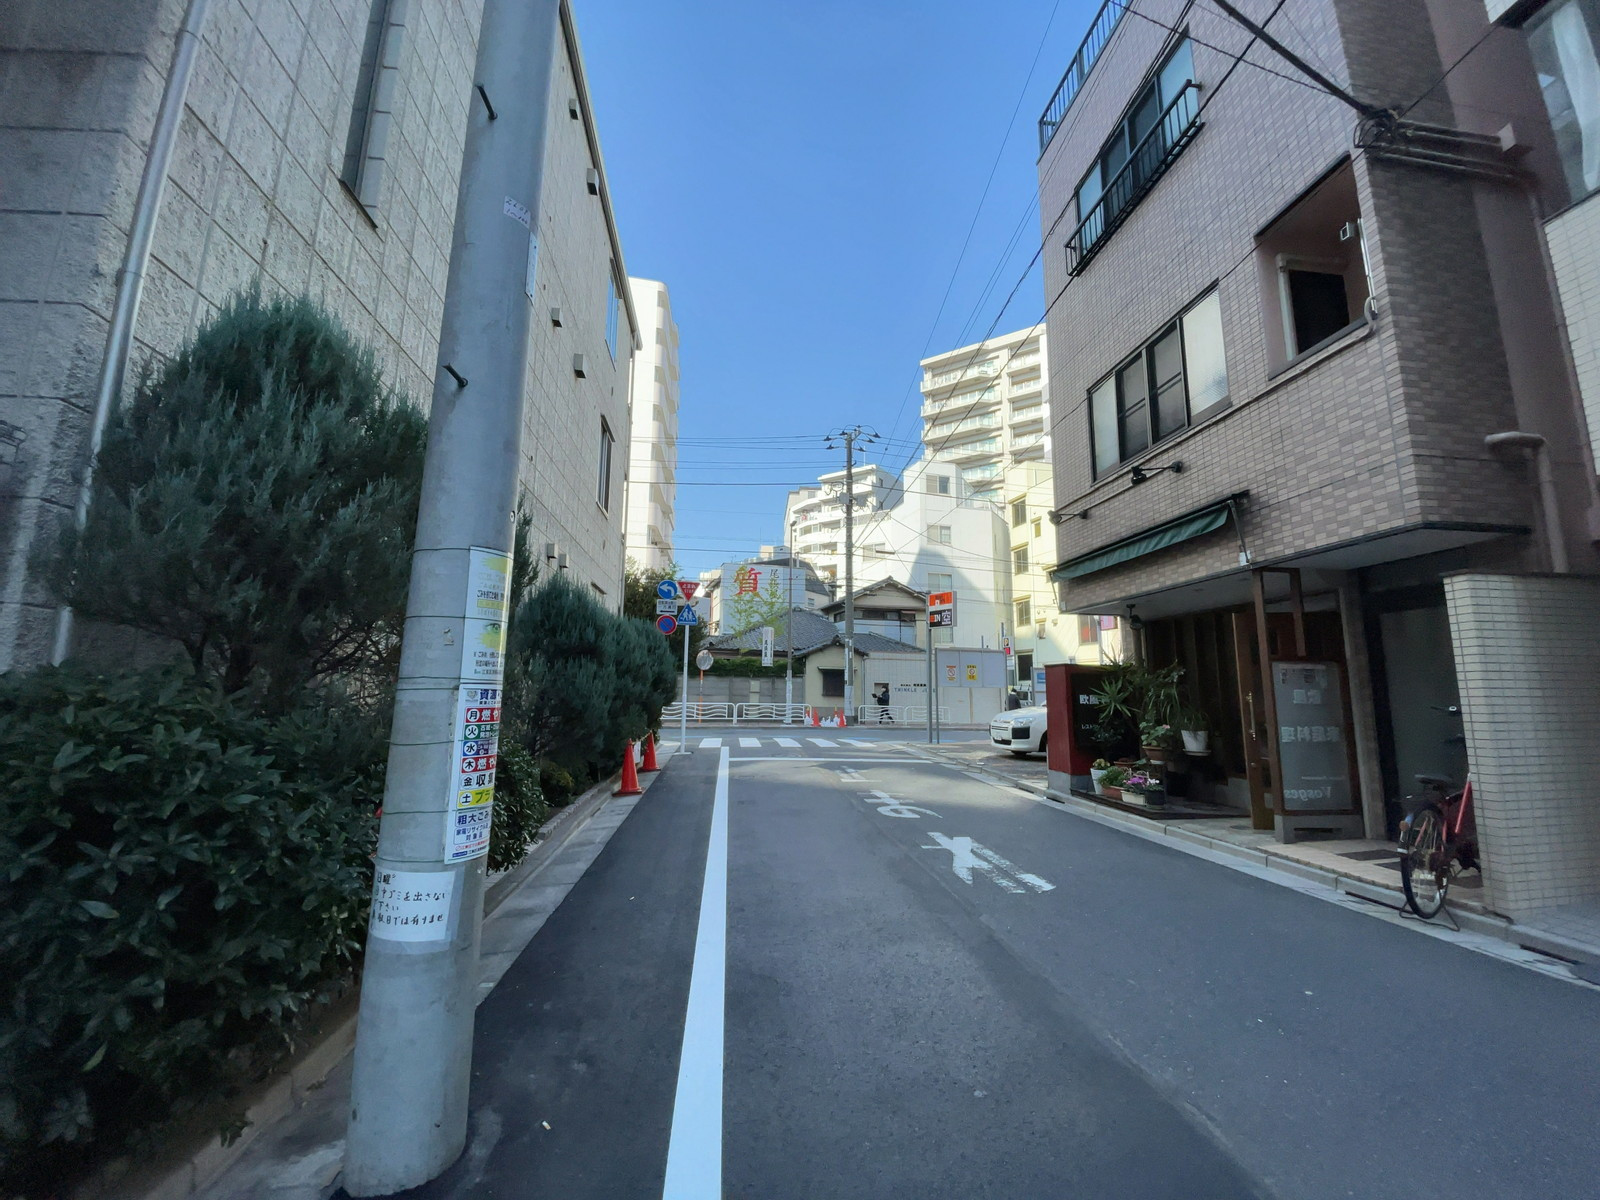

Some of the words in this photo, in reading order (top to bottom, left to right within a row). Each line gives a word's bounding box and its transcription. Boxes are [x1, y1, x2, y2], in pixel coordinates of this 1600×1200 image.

[734, 565, 762, 598] 質
[469, 711, 478, 720] 月
[481, 709, 501, 721] 燃や
[468, 727, 477, 737] 火
[466, 743, 475, 753] 水
[465, 760, 474, 770] 木
[477, 757, 496, 770] 燃や
[463, 776, 472, 787] 金
[462, 794, 471, 804] 土
[475, 789, 492, 803] プラ
[457, 811, 490, 825] 粗大ごみ
